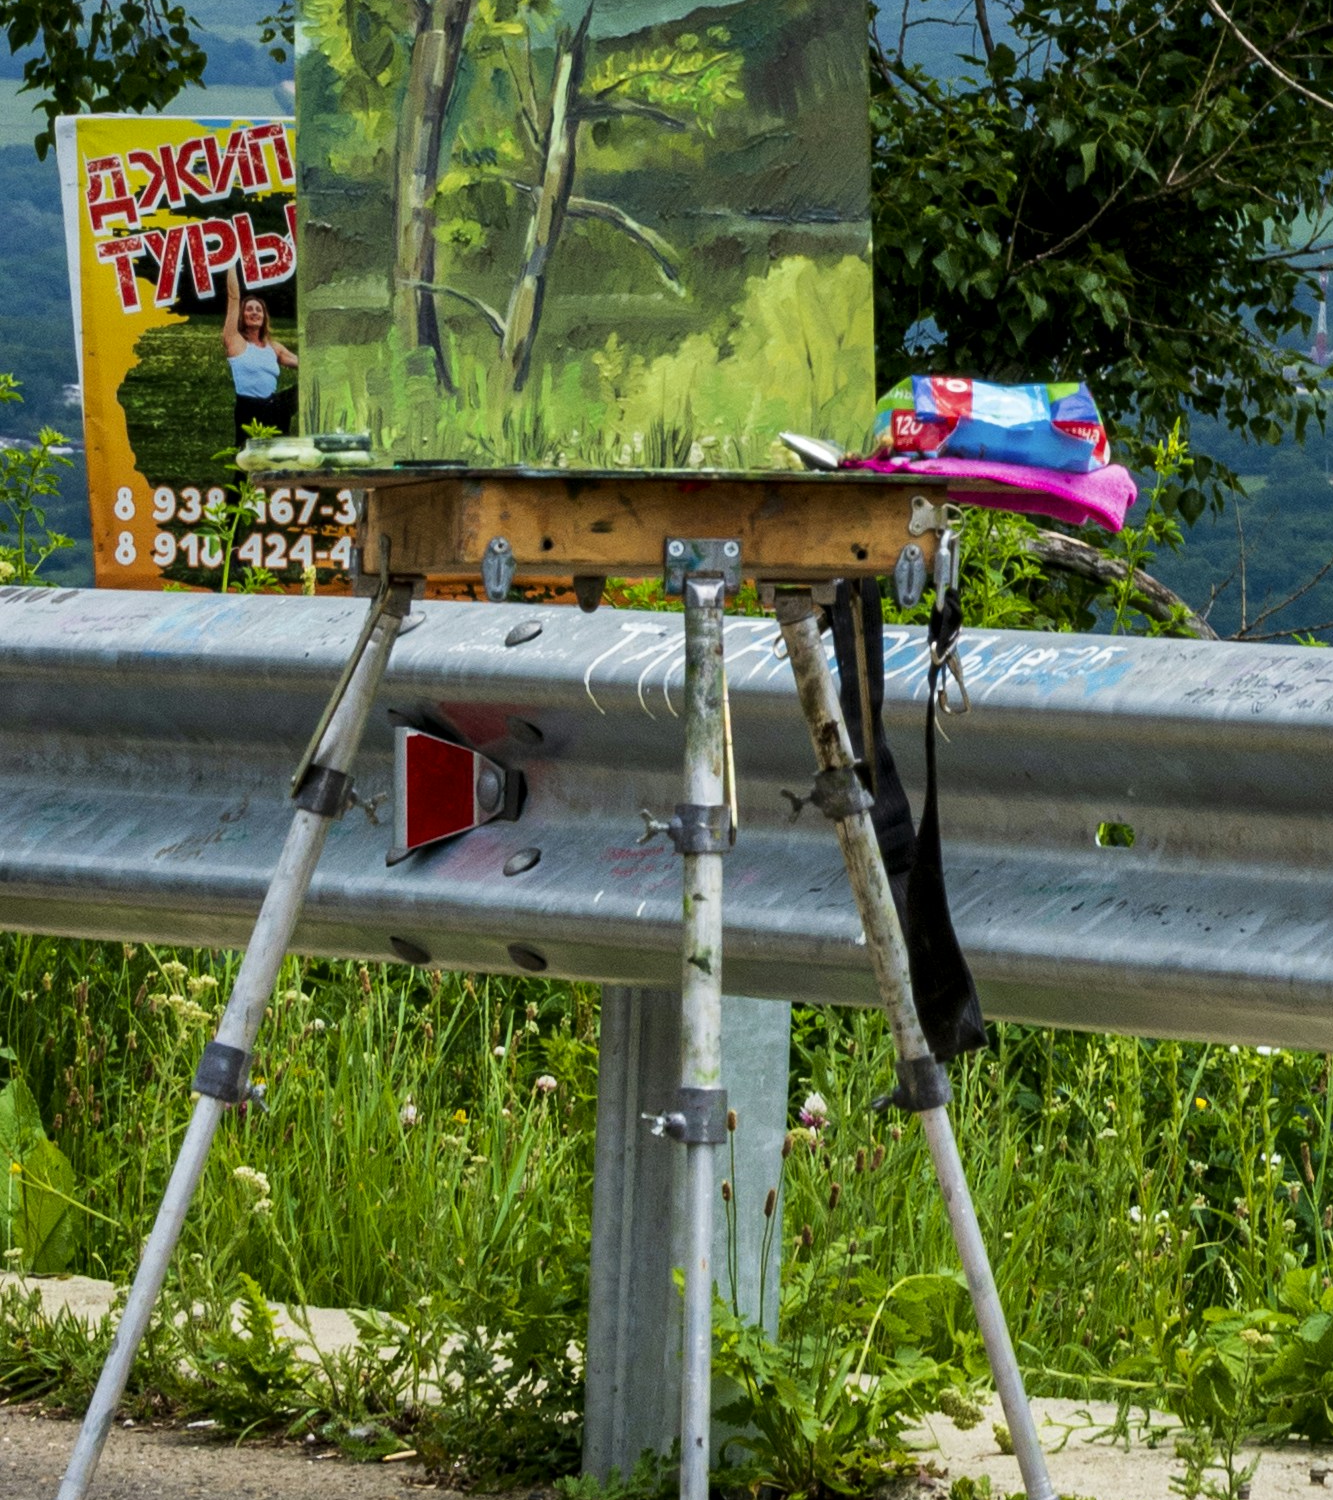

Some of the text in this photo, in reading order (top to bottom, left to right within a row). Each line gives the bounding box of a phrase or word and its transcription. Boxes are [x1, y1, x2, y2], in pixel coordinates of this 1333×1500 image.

[83, 123, 297, 237] ДЖИП
[96, 204, 297, 314] ТУРЫ
[114, 486, 136, 521] 8
[152, 486, 226, 524] 938
[115, 531, 137, 566] 8
